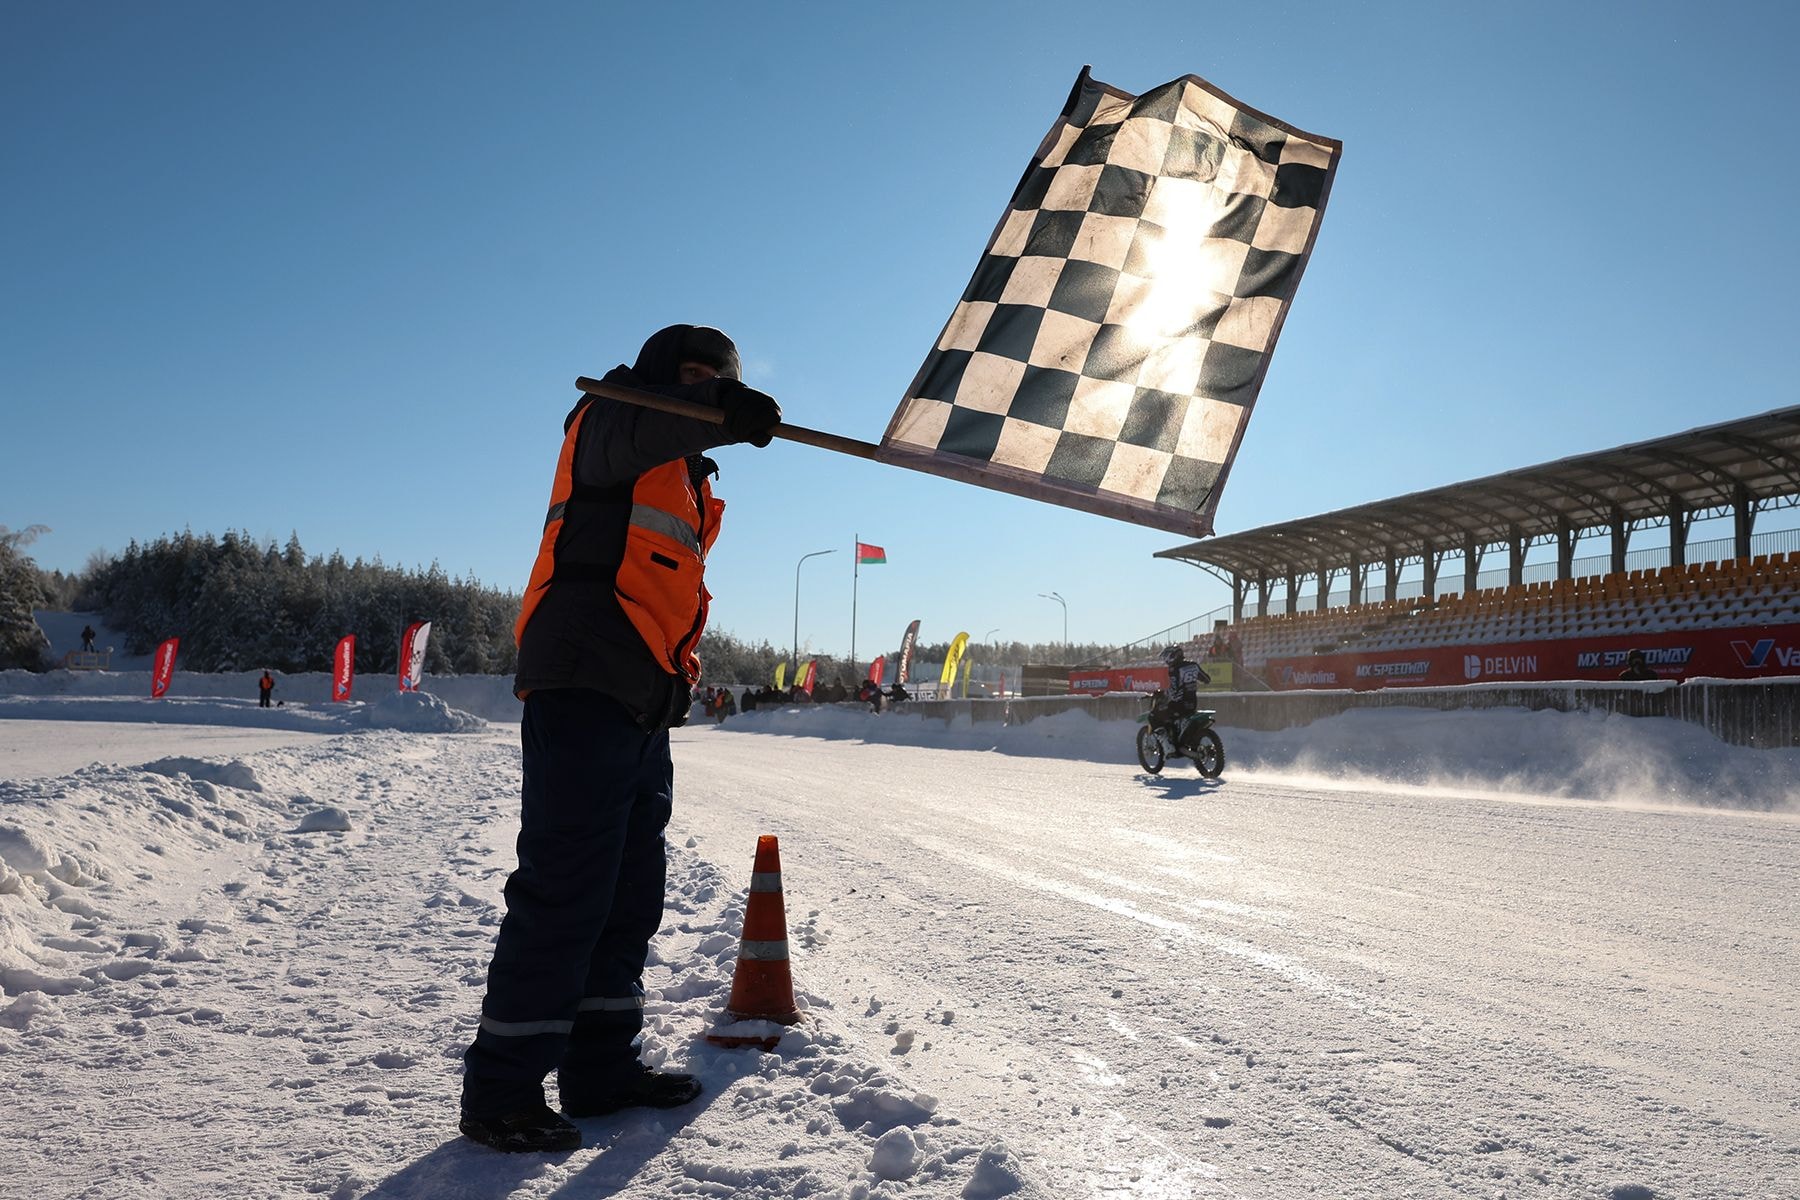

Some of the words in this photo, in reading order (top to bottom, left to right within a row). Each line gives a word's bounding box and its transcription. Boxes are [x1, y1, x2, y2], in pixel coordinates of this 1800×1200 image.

[342, 642, 350, 684] Valvoline
[1578, 653, 1601, 668] MX
[1603, 648, 1692, 666] SPDWAY
[1293, 671, 1336, 685] Valvoline
[1356, 664, 1371, 677] MX
[1374, 661, 1430, 675] SPEEDWAY
